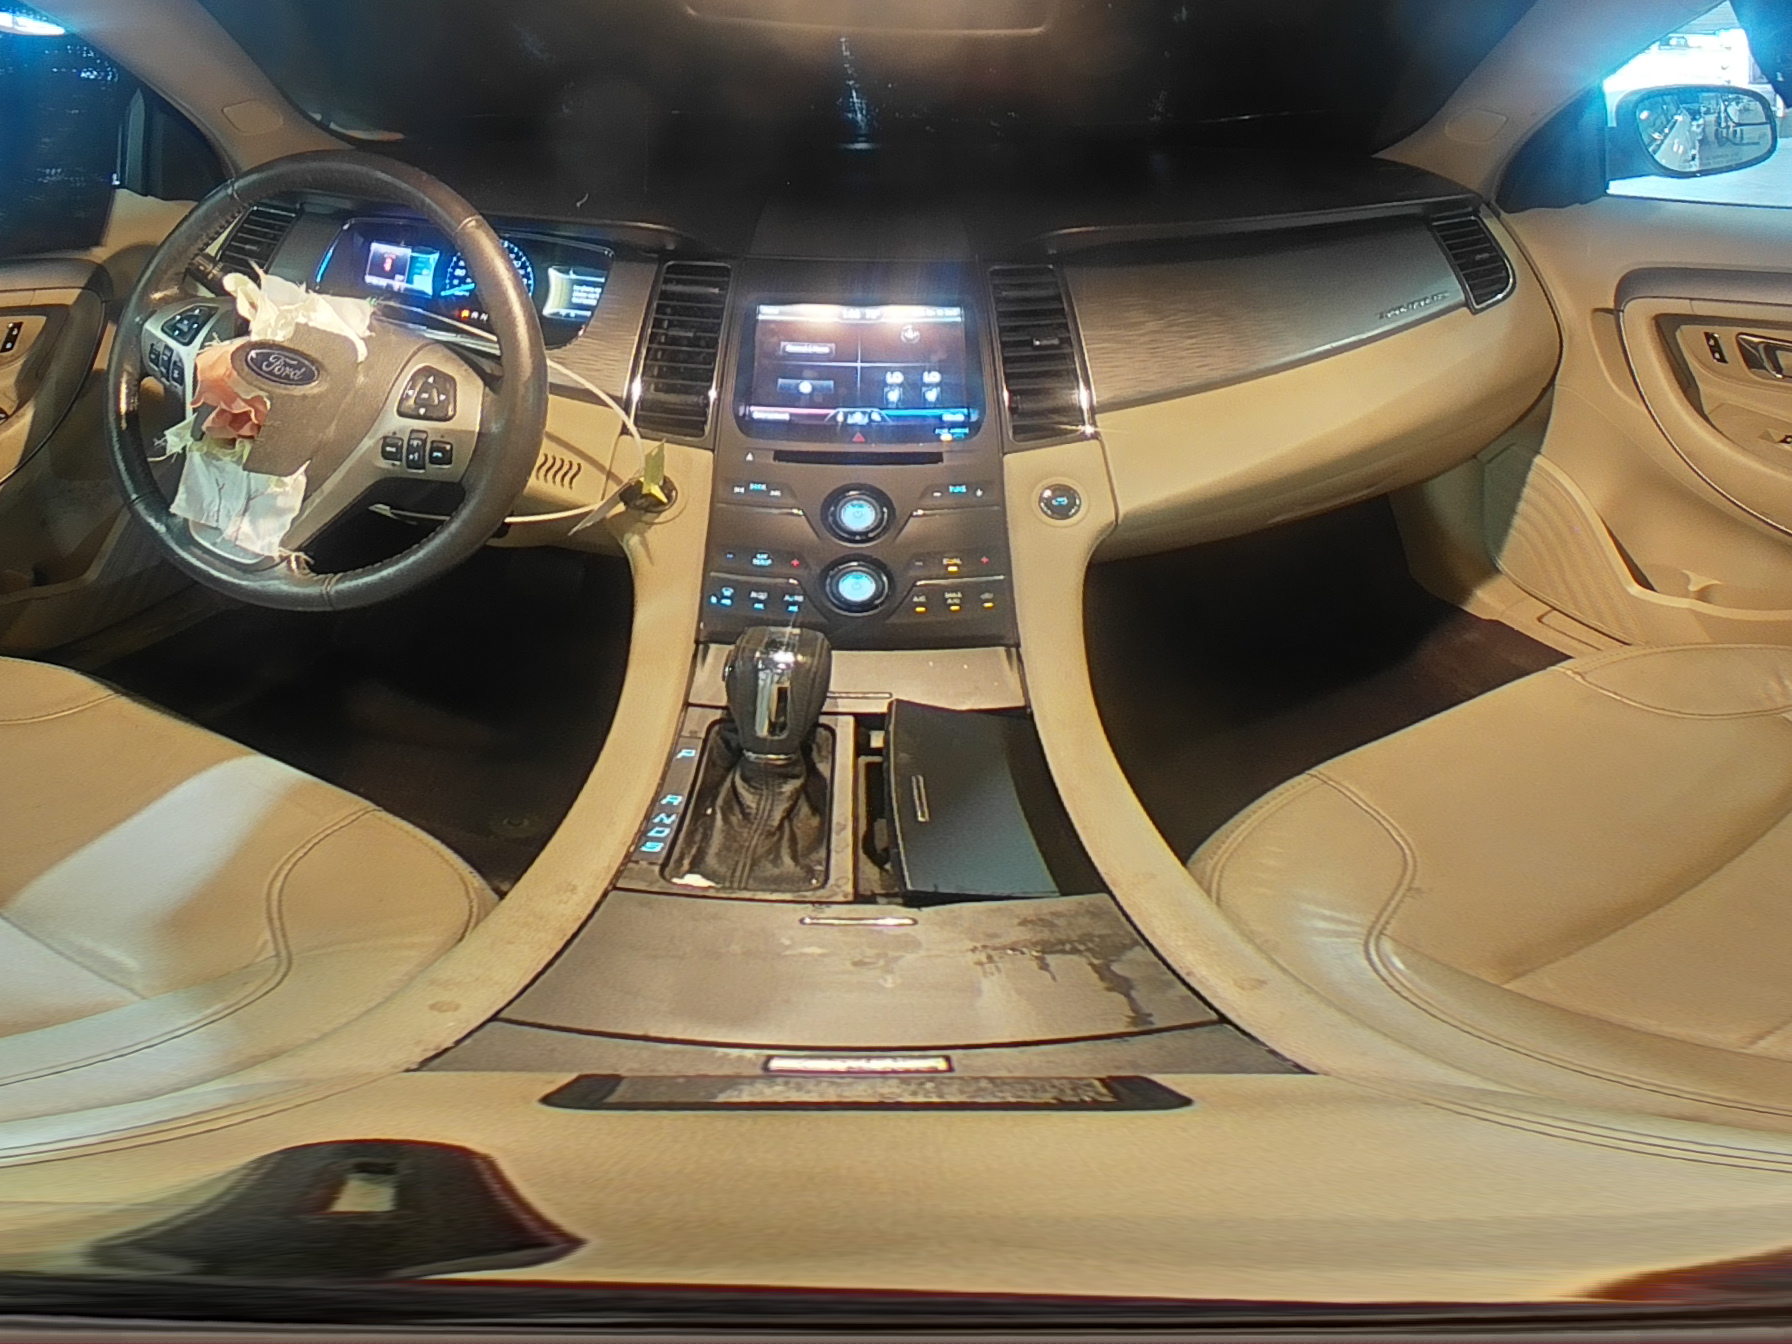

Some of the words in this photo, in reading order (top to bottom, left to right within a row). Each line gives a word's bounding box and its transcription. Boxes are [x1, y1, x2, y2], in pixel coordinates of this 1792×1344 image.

[261, 353, 306, 380] Ford
[675, 748, 696, 759] P
[660, 794, 683, 805] R
[652, 812, 677, 824] N
[646, 826, 672, 838] D
[639, 841, 665, 852] S
